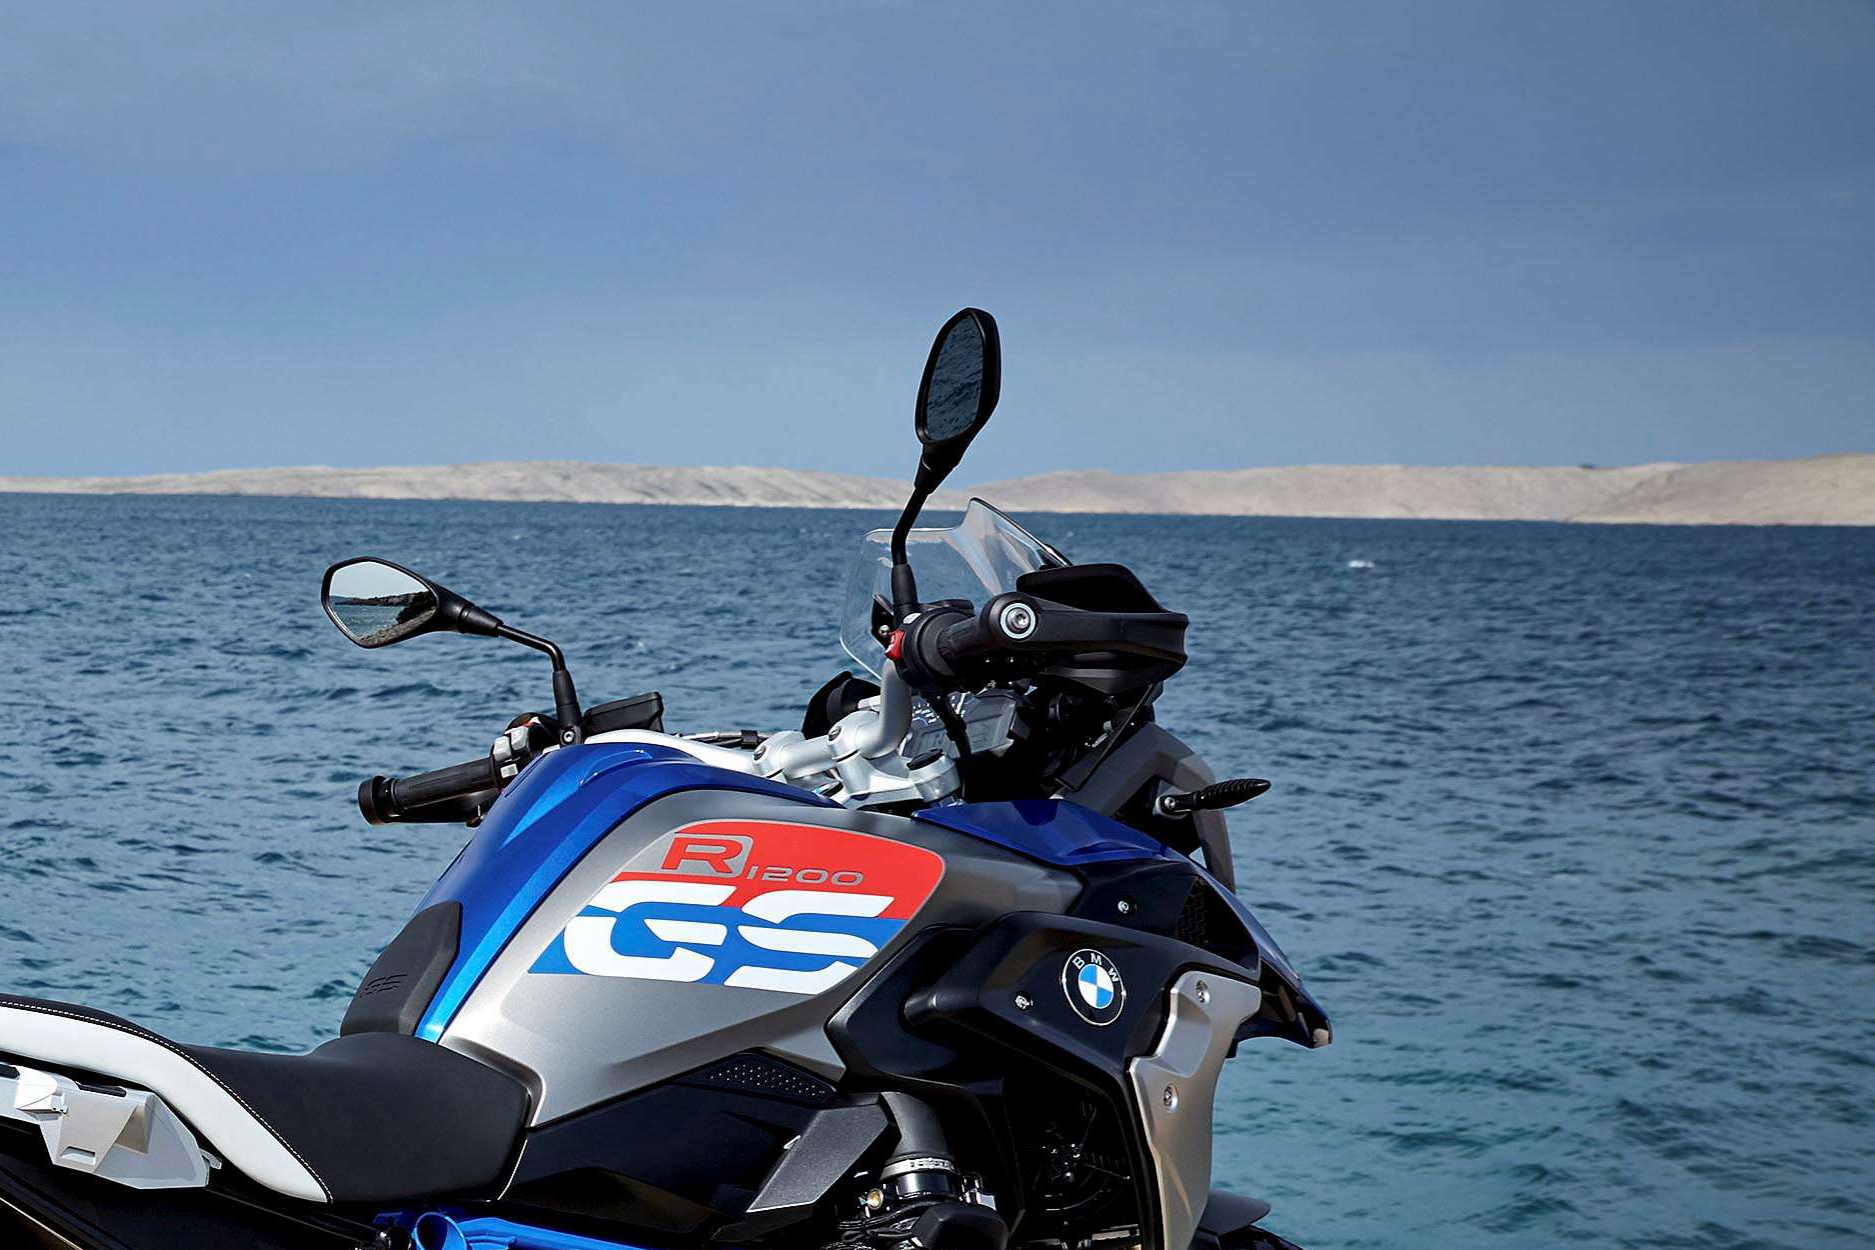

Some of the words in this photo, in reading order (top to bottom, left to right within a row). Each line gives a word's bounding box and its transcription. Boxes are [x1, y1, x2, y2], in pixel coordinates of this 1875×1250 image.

[661, 838, 743, 875] R
[746, 866, 864, 887] 1200
[563, 880, 895, 995] GS
[1071, 953, 1120, 983] BMW
